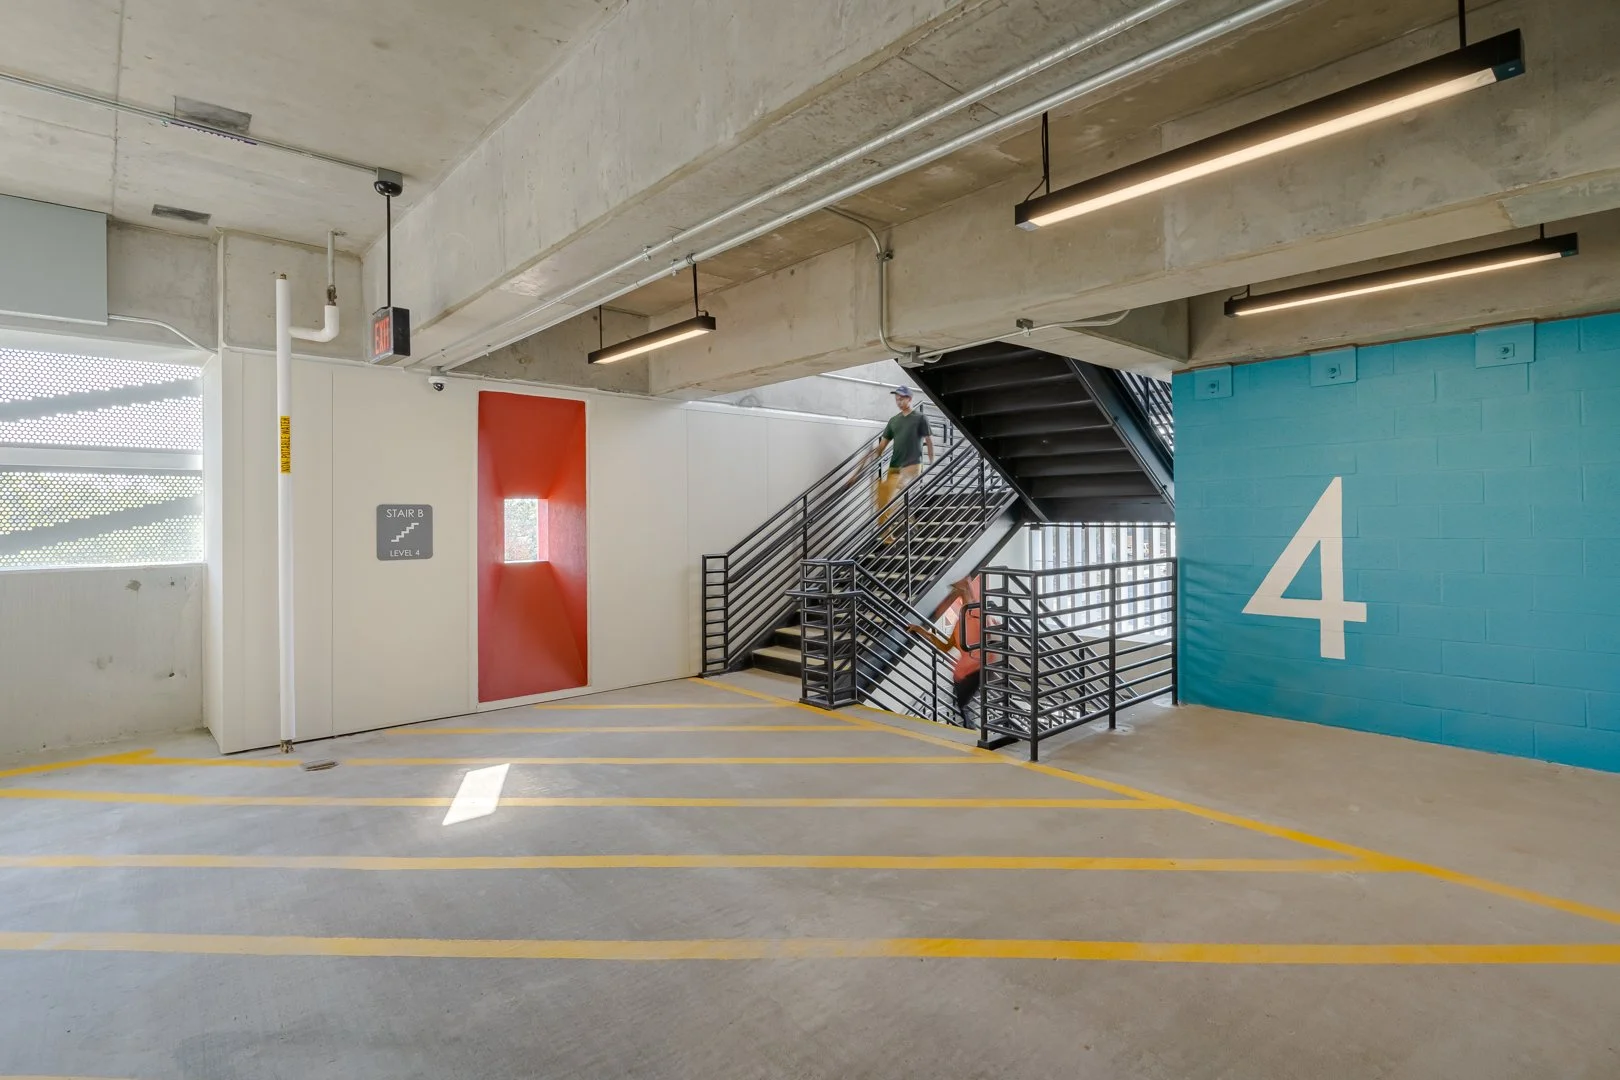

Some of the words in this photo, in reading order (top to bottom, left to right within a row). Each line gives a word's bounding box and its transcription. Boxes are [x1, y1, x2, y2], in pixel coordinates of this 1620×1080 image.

[375, 316, 391, 355] EXIT
[281, 417, 291, 435] WATER
[281, 436, 291, 473] NON-POTABLE
[386, 508, 415, 518] STAIR
[417, 508, 424, 518] B
[390, 549, 413, 557] LEVEL
[415, 549, 420, 557] 4
[1241, 476, 1367, 660] 4
